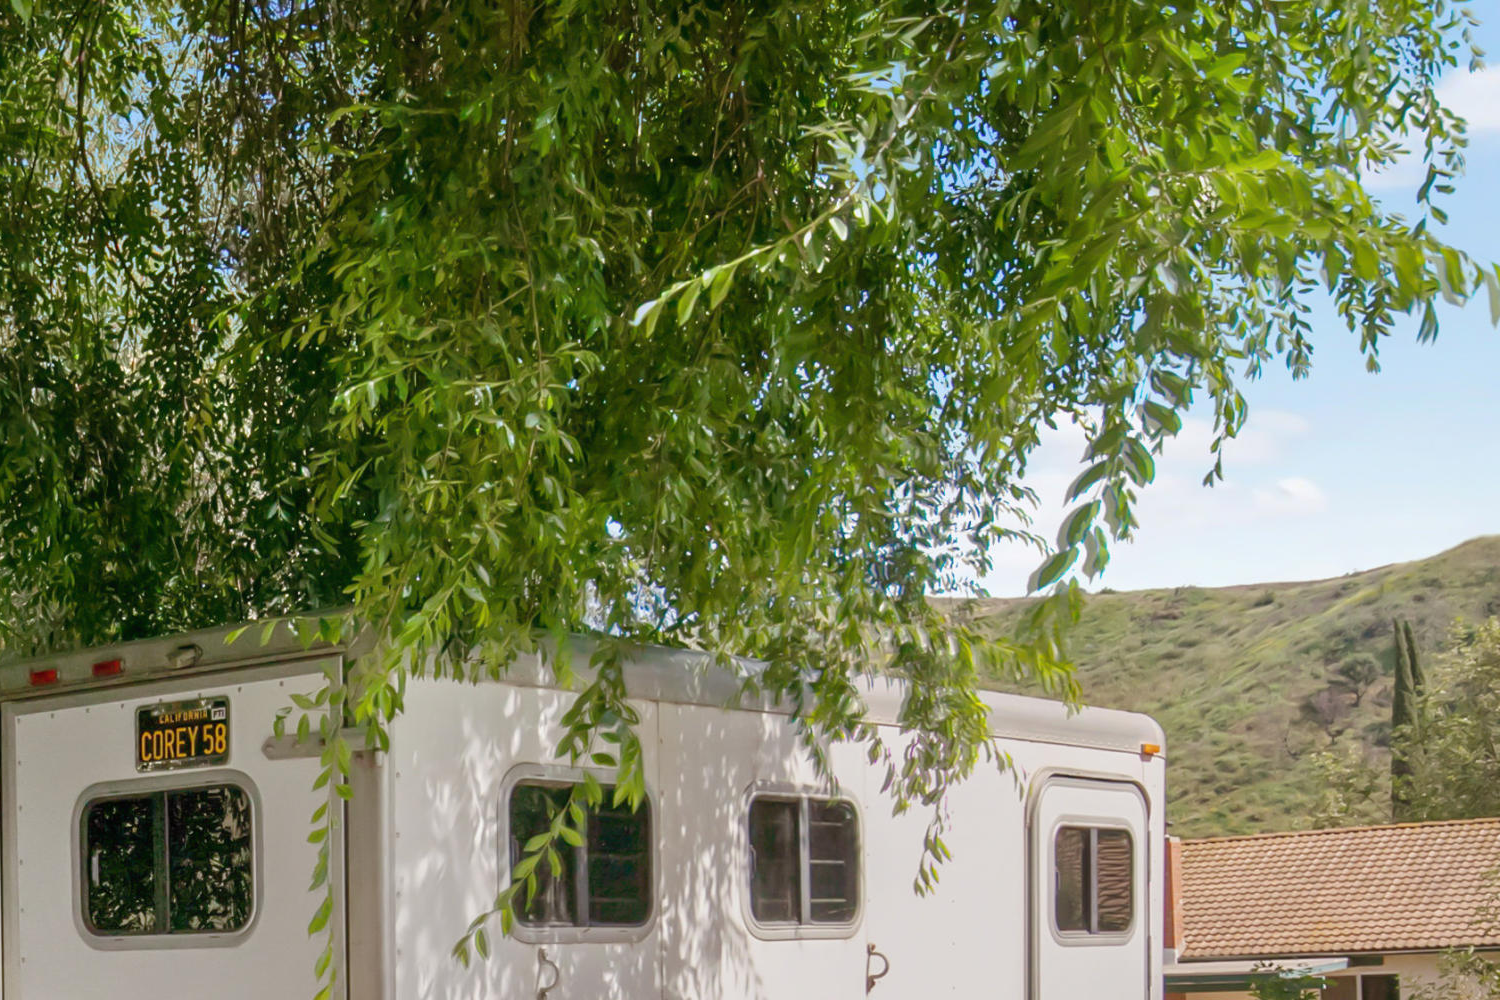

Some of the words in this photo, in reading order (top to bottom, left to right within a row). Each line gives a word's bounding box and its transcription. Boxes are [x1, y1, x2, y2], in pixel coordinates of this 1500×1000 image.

[158, 708, 208, 724] CALIFORNIA
[141, 725, 199, 761] COREY
[202, 723, 226, 755] 58
